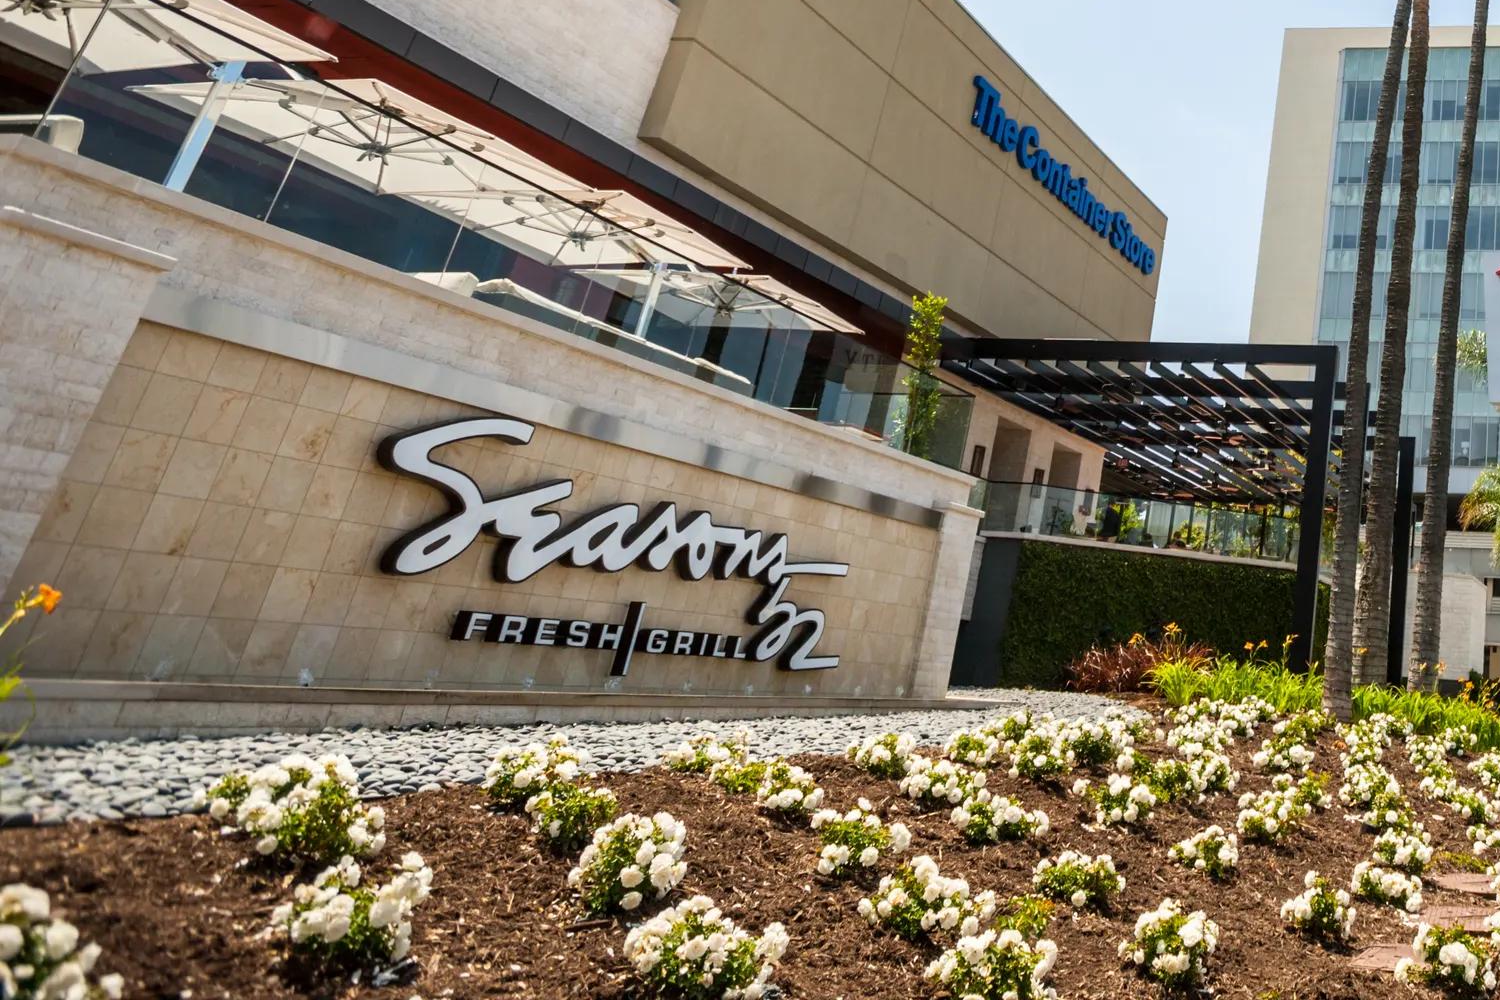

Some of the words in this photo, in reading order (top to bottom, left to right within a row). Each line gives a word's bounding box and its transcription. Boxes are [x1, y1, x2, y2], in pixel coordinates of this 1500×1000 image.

[971, 74, 1019, 152] The
[1016, 125, 1113, 238] Container
[1108, 211, 1156, 275] Store
[377, 416, 849, 583] Seasons
[452, 610, 626, 651] FRESH
[640, 628, 747, 660] GRILL
[748, 574, 840, 671] 52
